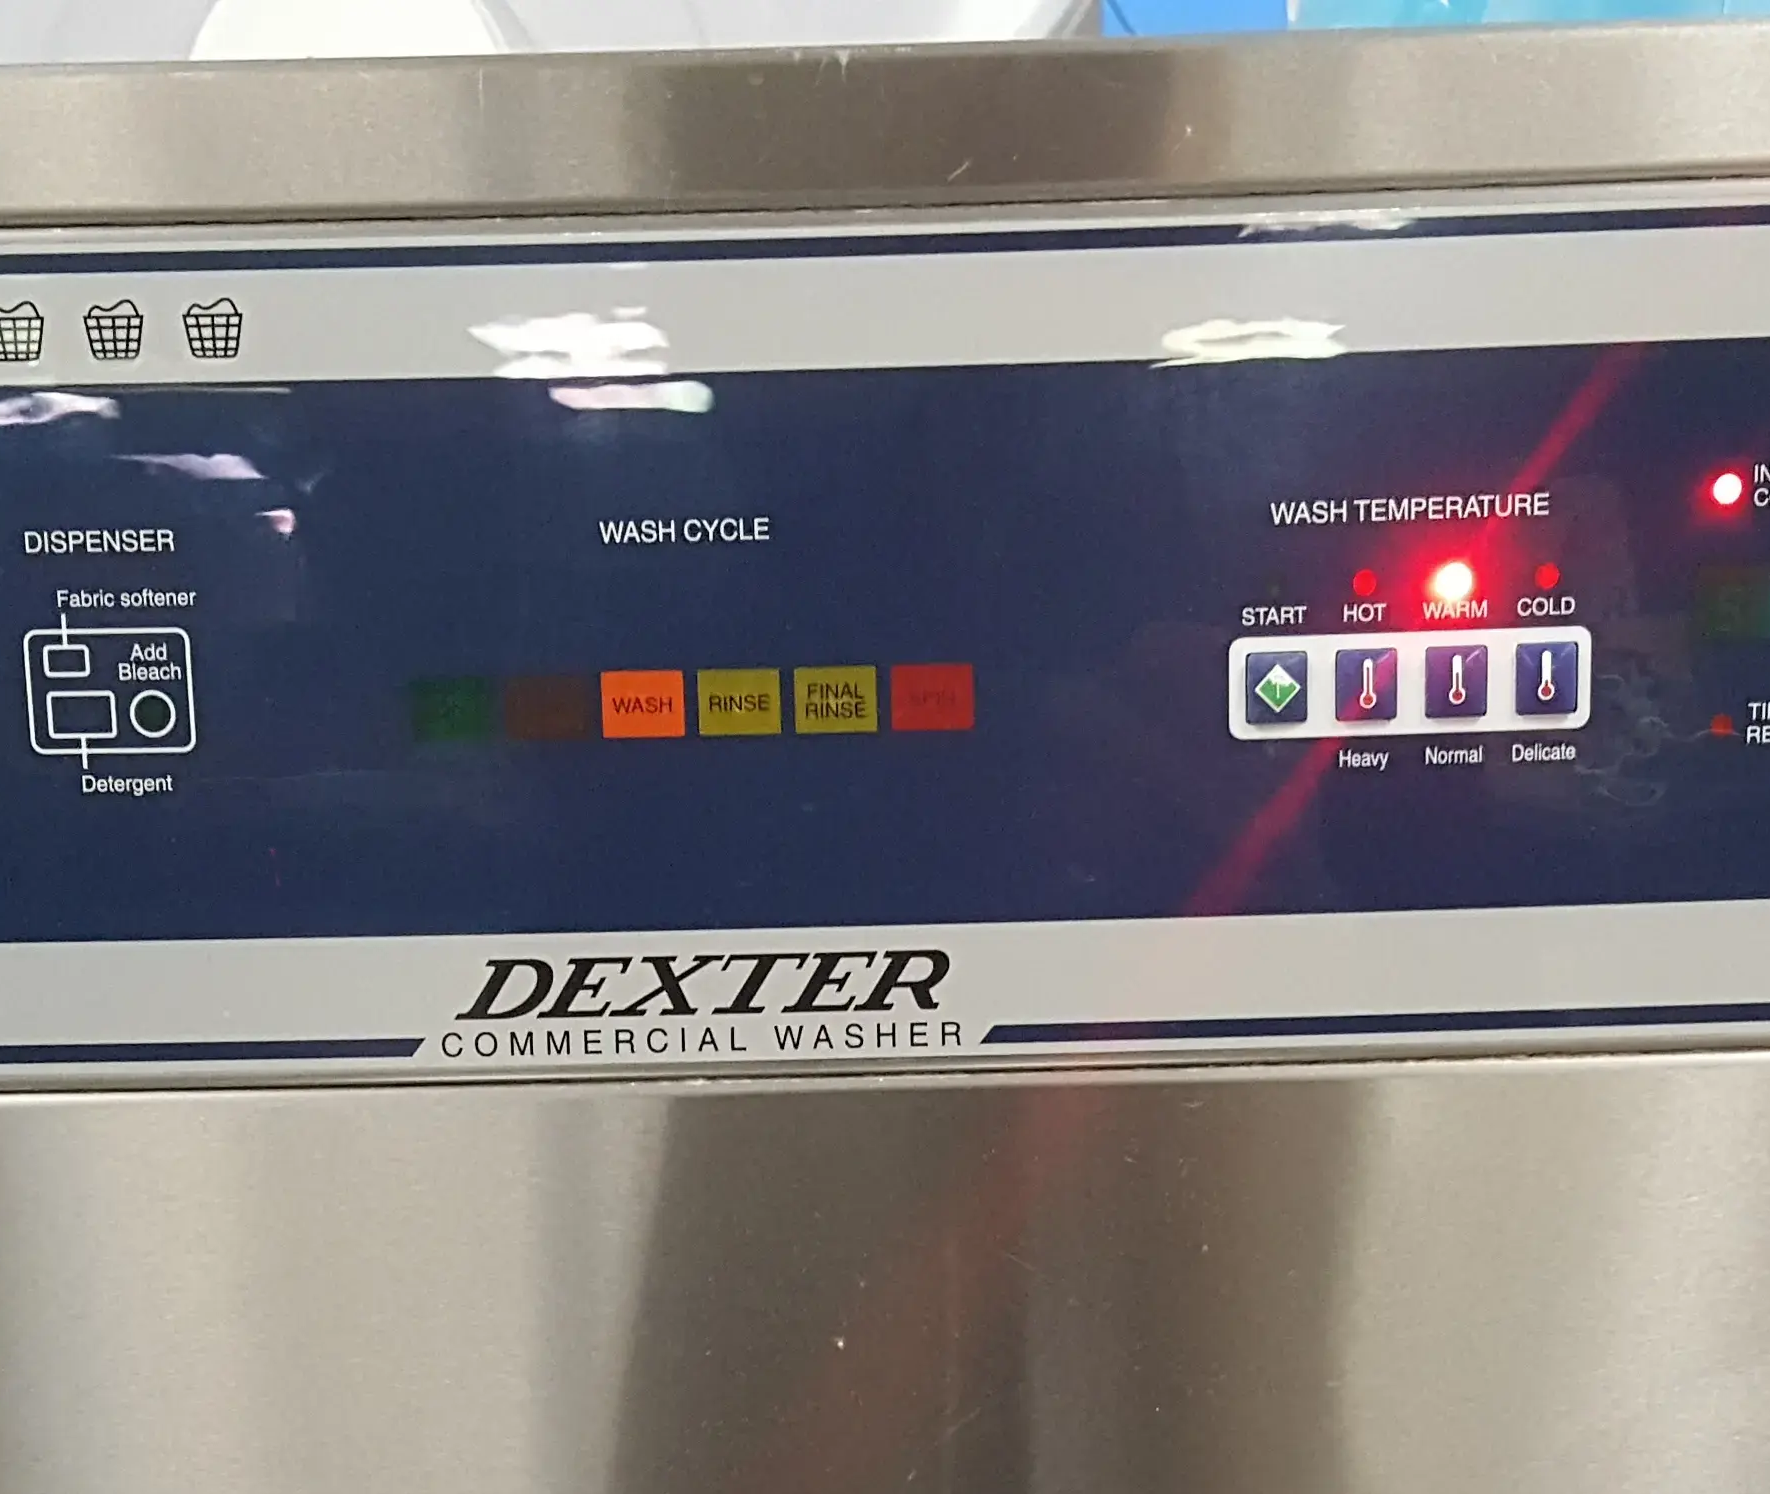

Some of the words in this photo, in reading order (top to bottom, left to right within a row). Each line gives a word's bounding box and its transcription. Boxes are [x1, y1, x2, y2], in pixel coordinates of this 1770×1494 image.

[1271, 500, 1347, 525] WASH
[1354, 493, 1549, 526] TEMPERATURE
[600, 520, 675, 544] WASH
[684, 518, 769, 541] CYCLE
[24, 530, 174, 553] DISPENSER
[57, 589, 114, 607] Fabric
[121, 589, 196, 607] softener
[1517, 597, 1575, 616] COLD
[1242, 606, 1307, 625] START
[1344, 603, 1386, 622] HOT
[1423, 600, 1487, 619] WARM
[130, 643, 167, 661] Add
[118, 662, 181, 680] Bleach
[808, 682, 864, 699] FINAL
[612, 697, 672, 714] WASH
[709, 694, 768, 712] RINSE
[806, 700, 866, 719] RINSE
[1339, 750, 1388, 770] Heavy
[1426, 745, 1483, 764] Normal
[1512, 743, 1576, 762] Delicate
[82, 775, 173, 796] Detergent
[455, 950, 949, 1020] DEXTER
[442, 1027, 746, 1057] COMMERCIAL
[774, 1022, 961, 1050] WASHER
